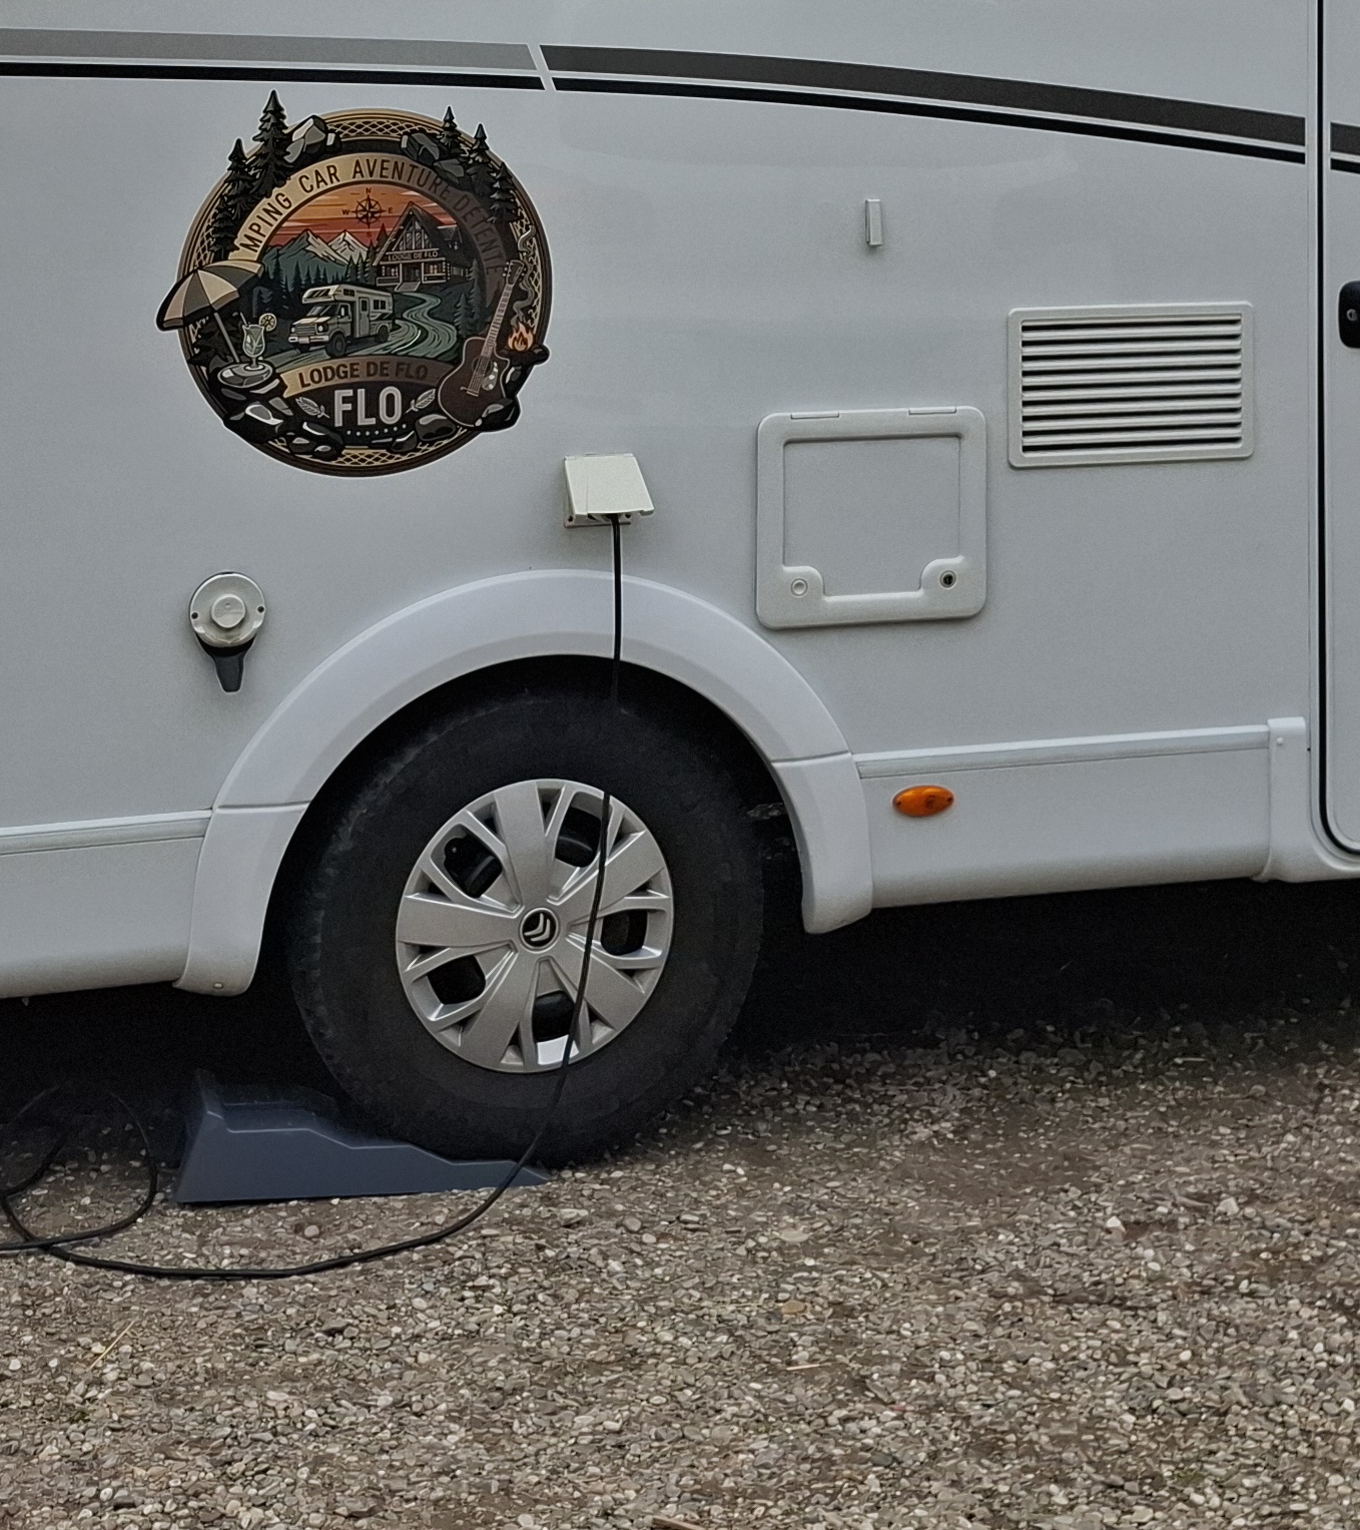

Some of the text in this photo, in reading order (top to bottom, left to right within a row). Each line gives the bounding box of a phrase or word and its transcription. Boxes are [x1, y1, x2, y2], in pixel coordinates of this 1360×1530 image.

[298, 164, 341, 193] CAR
[351, 158, 452, 201] AVENTURE
[298, 361, 428, 388] LODGE DE FLO
[333, 386, 402, 427] FLO
